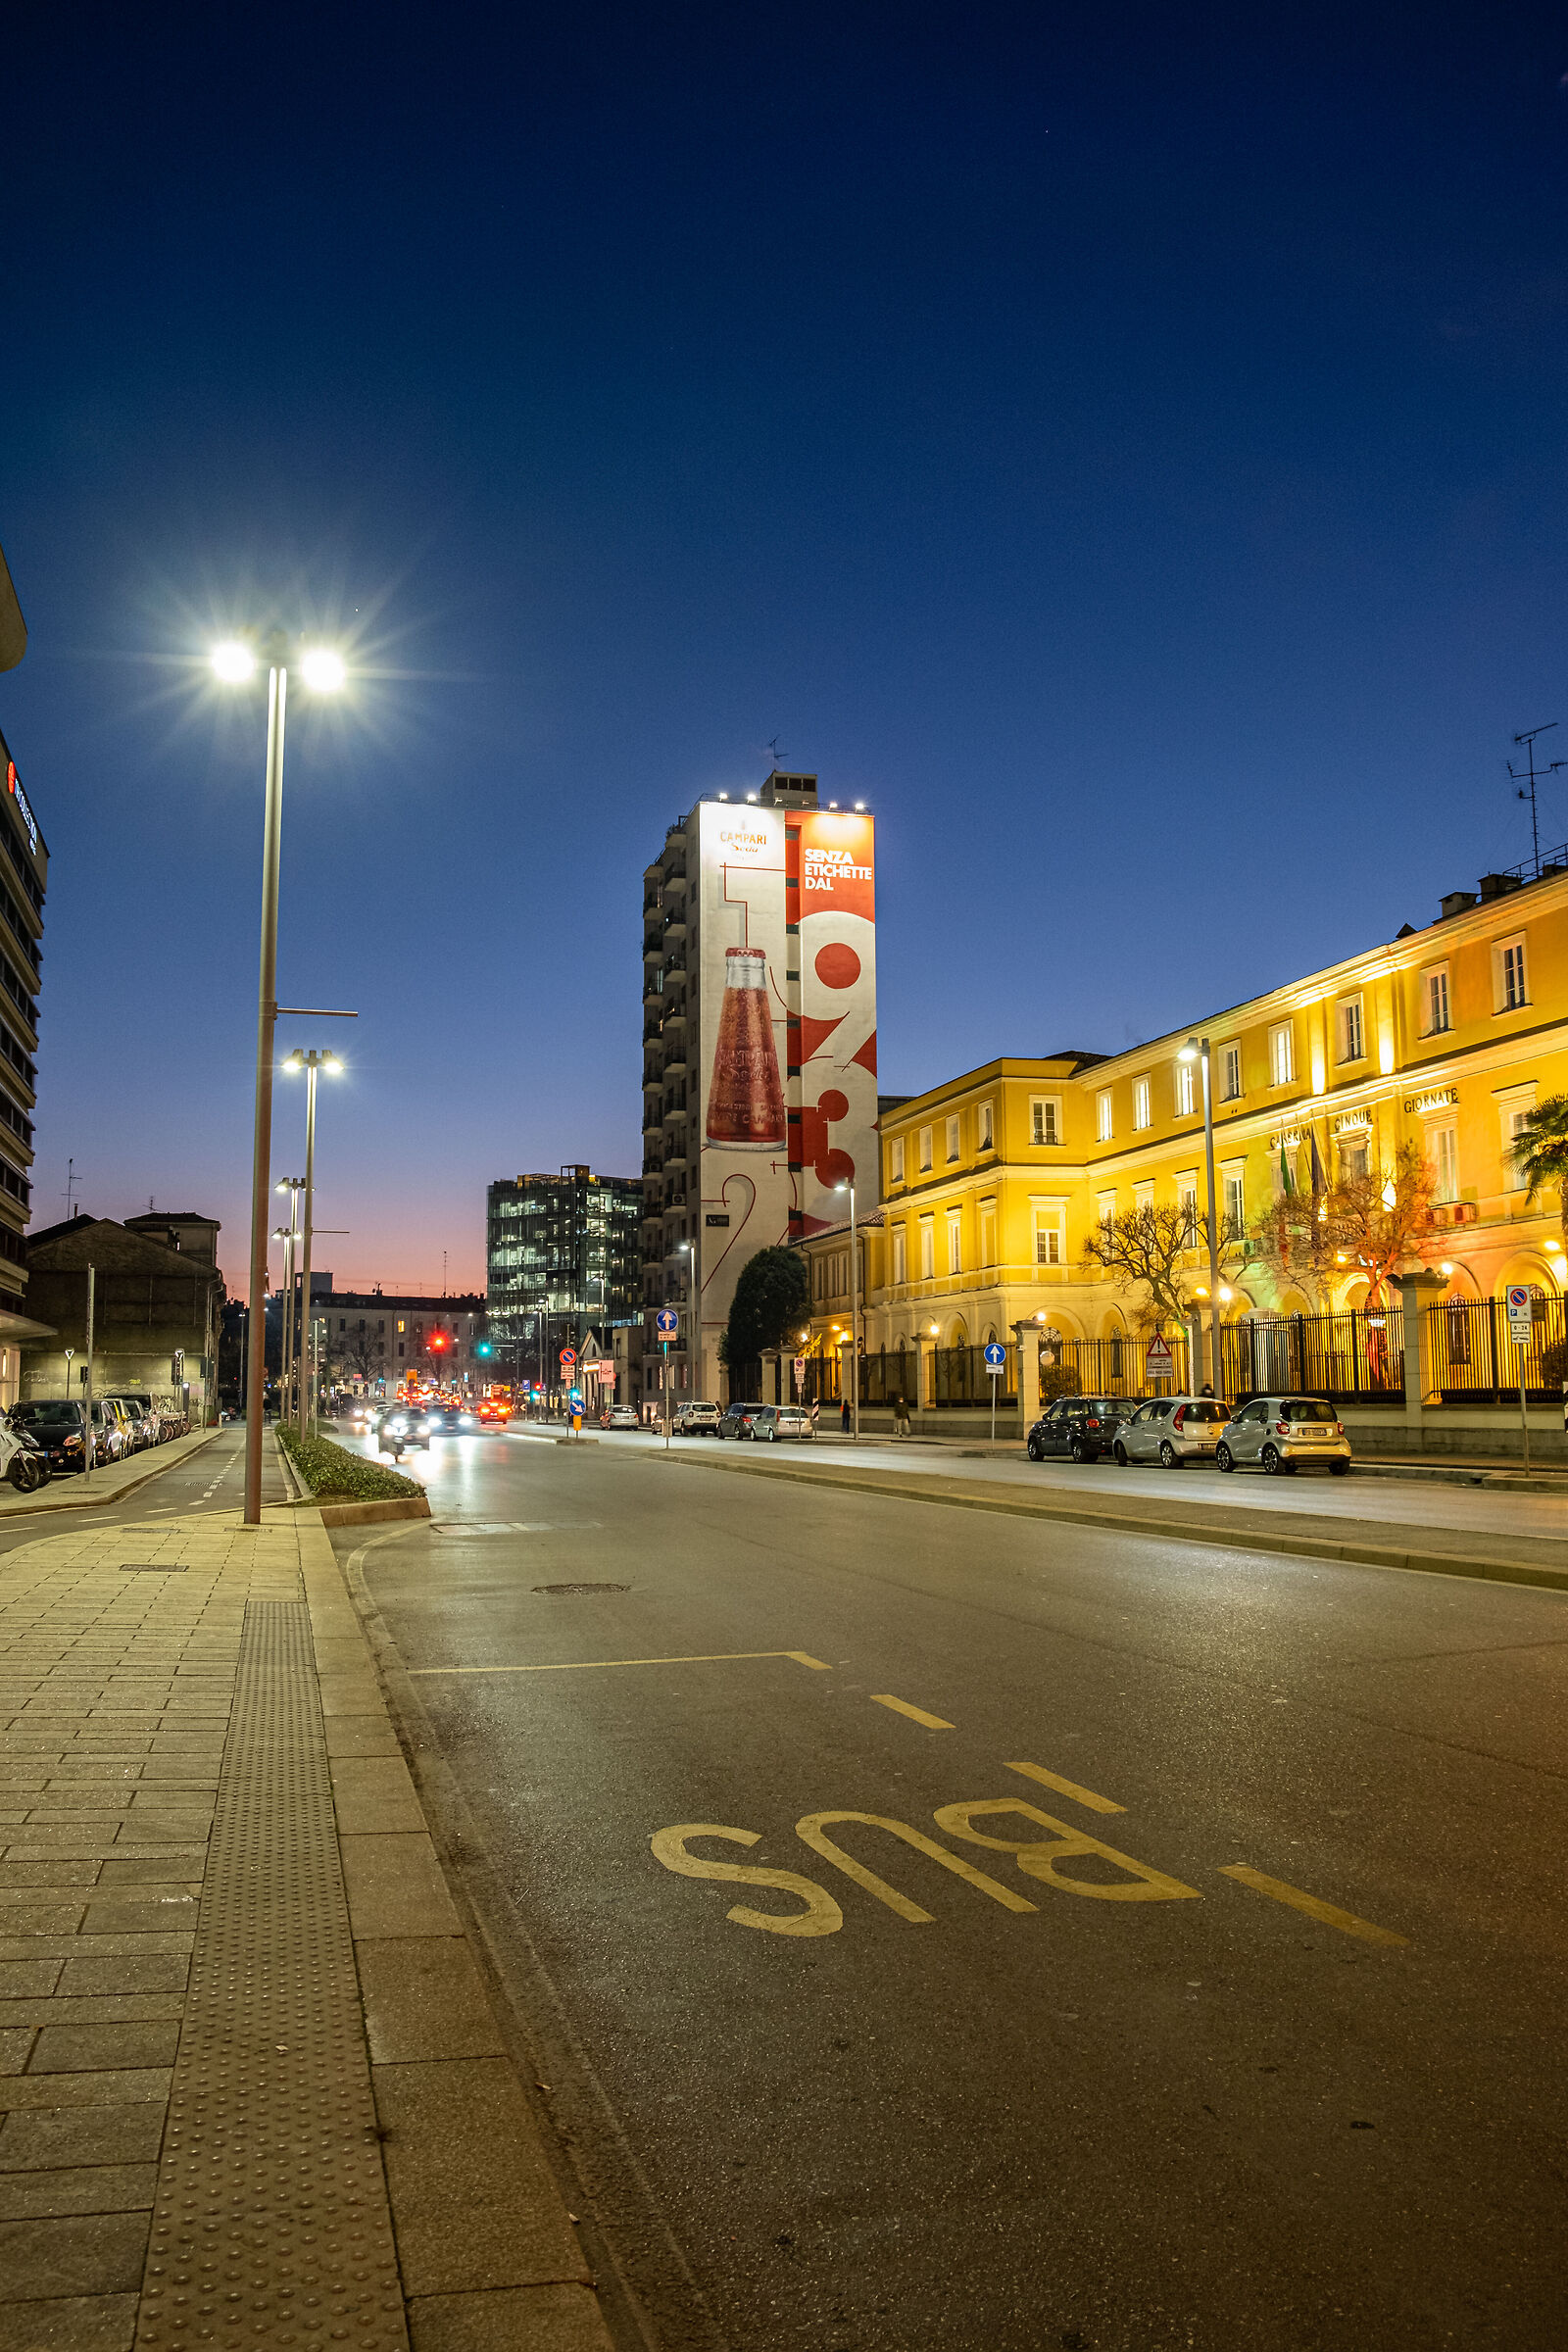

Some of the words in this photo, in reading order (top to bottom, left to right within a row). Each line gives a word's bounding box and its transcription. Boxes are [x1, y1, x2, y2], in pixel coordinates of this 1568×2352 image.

[720, 832, 766, 845] CAMPARI
[805, 849, 854, 864] SENZA
[805, 862, 872, 880] ETICHETTE
[805, 876, 834, 891] DAL
[1334, 1109, 1373, 1133] CINQUE
[1403, 1087, 1460, 1114] GIORNATE
[651, 1797, 1203, 1937] BUS
